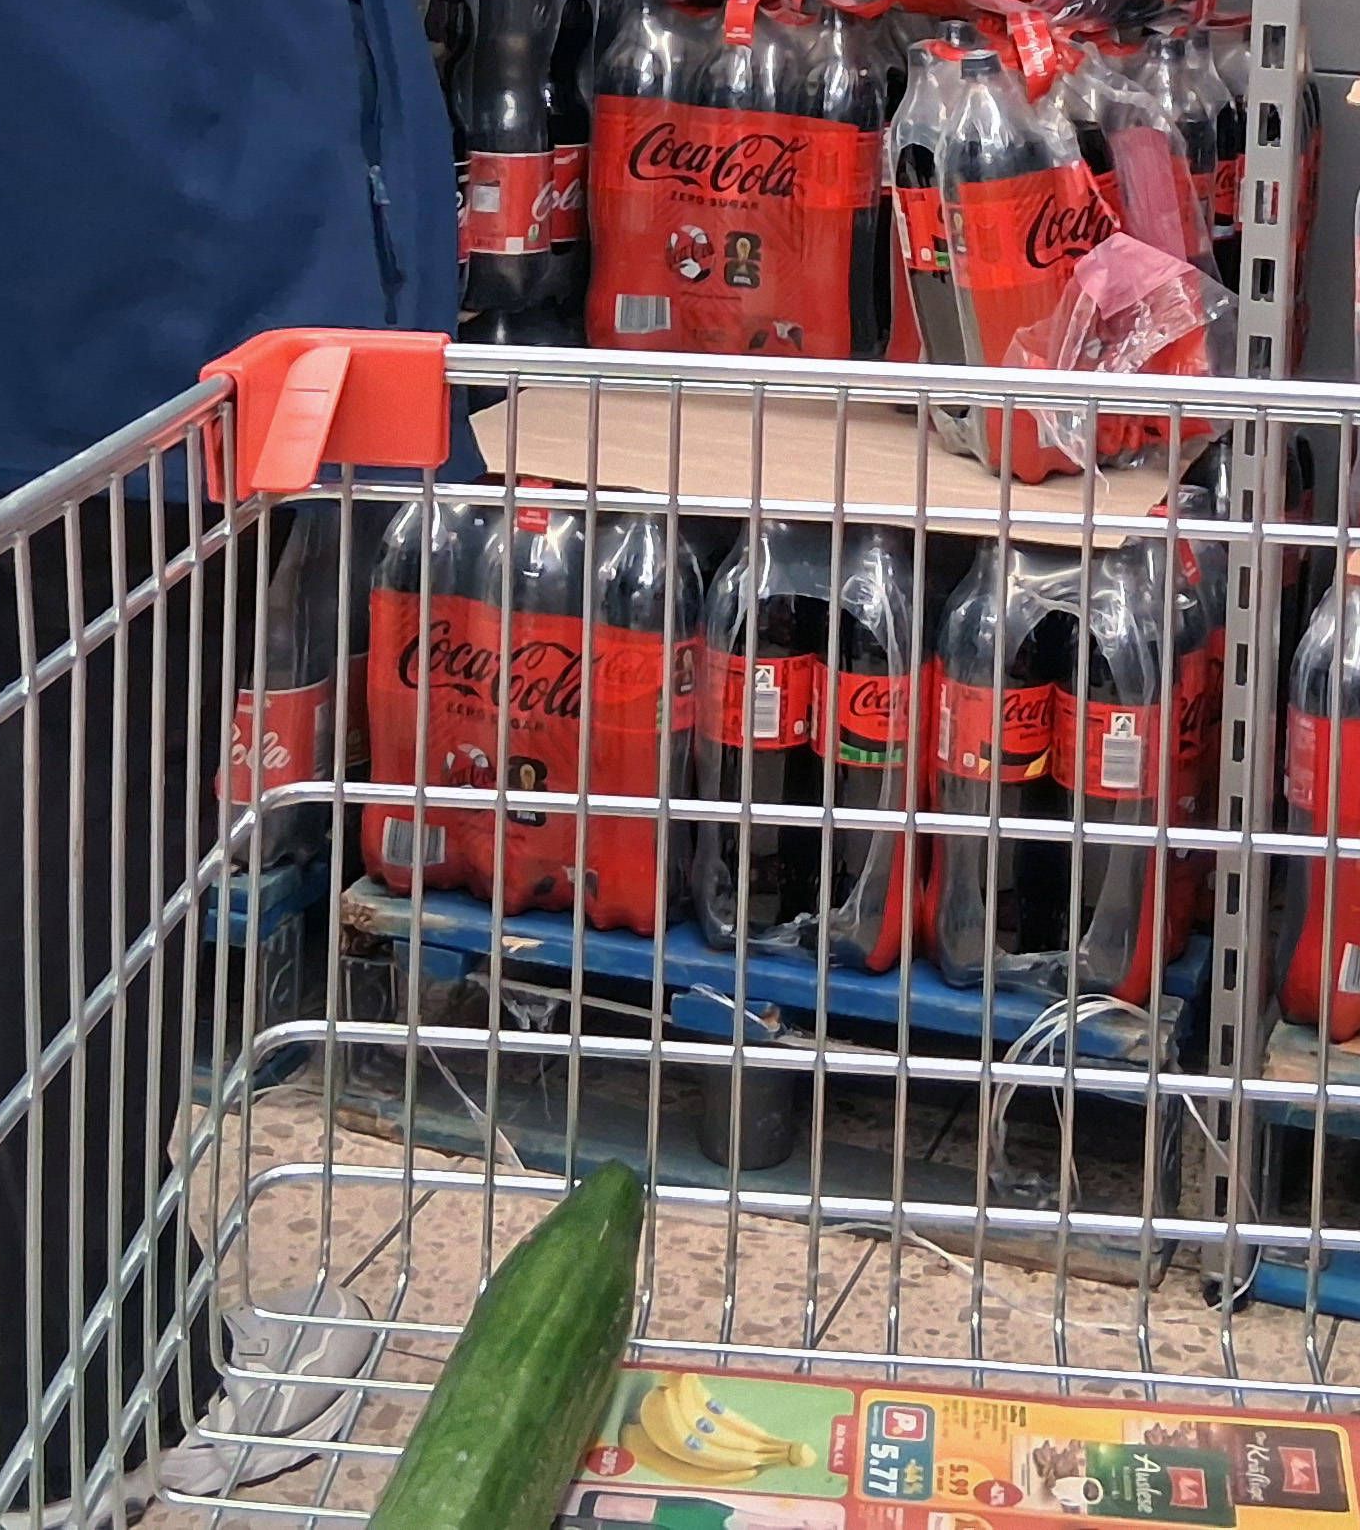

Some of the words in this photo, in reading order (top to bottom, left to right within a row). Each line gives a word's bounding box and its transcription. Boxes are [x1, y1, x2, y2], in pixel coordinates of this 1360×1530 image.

[629, 122, 809, 197] Coca-Cola
[670, 190, 705, 205] ZERO
[709, 198, 759, 210] SUGAR
[399, 620, 604, 718] Coca-Cola
[868, 1443, 900, 1495] 5.77
[948, 1463, 969, 1496] 5.99
